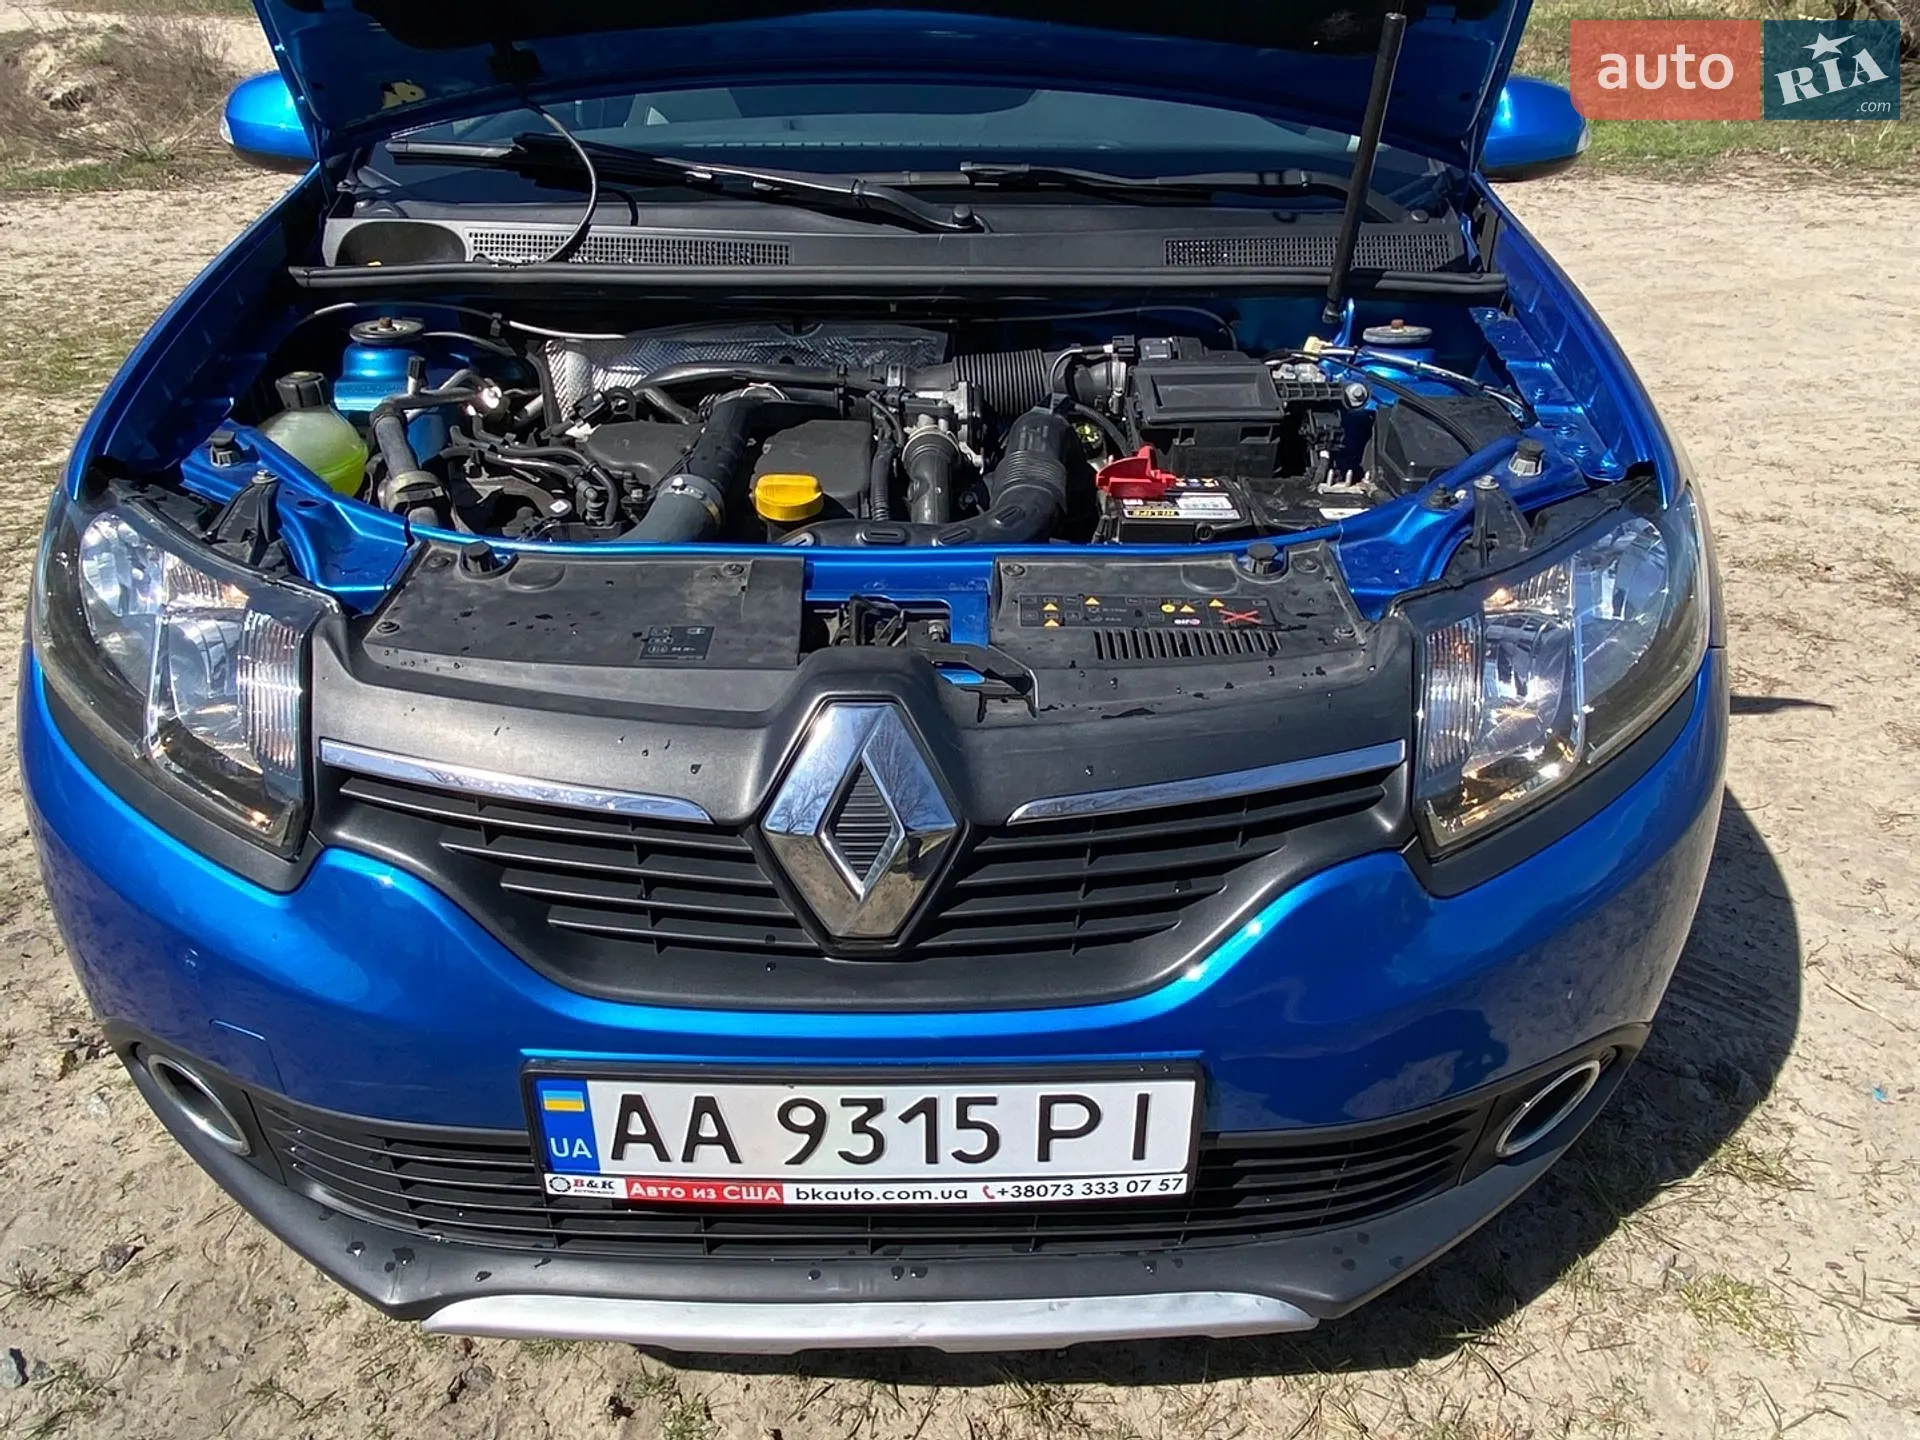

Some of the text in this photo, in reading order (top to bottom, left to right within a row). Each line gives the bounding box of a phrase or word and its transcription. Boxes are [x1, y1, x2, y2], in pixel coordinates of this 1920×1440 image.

[611, 1093, 1151, 1166] AA 9315 PI
[550, 1137, 593, 1159] UA
[630, 1182, 686, 1198] Авто
[692, 1187, 716, 1199] из
[723, 1185, 781, 1201] США
[795, 1188, 968, 1201] bkauto.com.ua
[997, 1178, 1184, 1199] +38073 333 07 57
